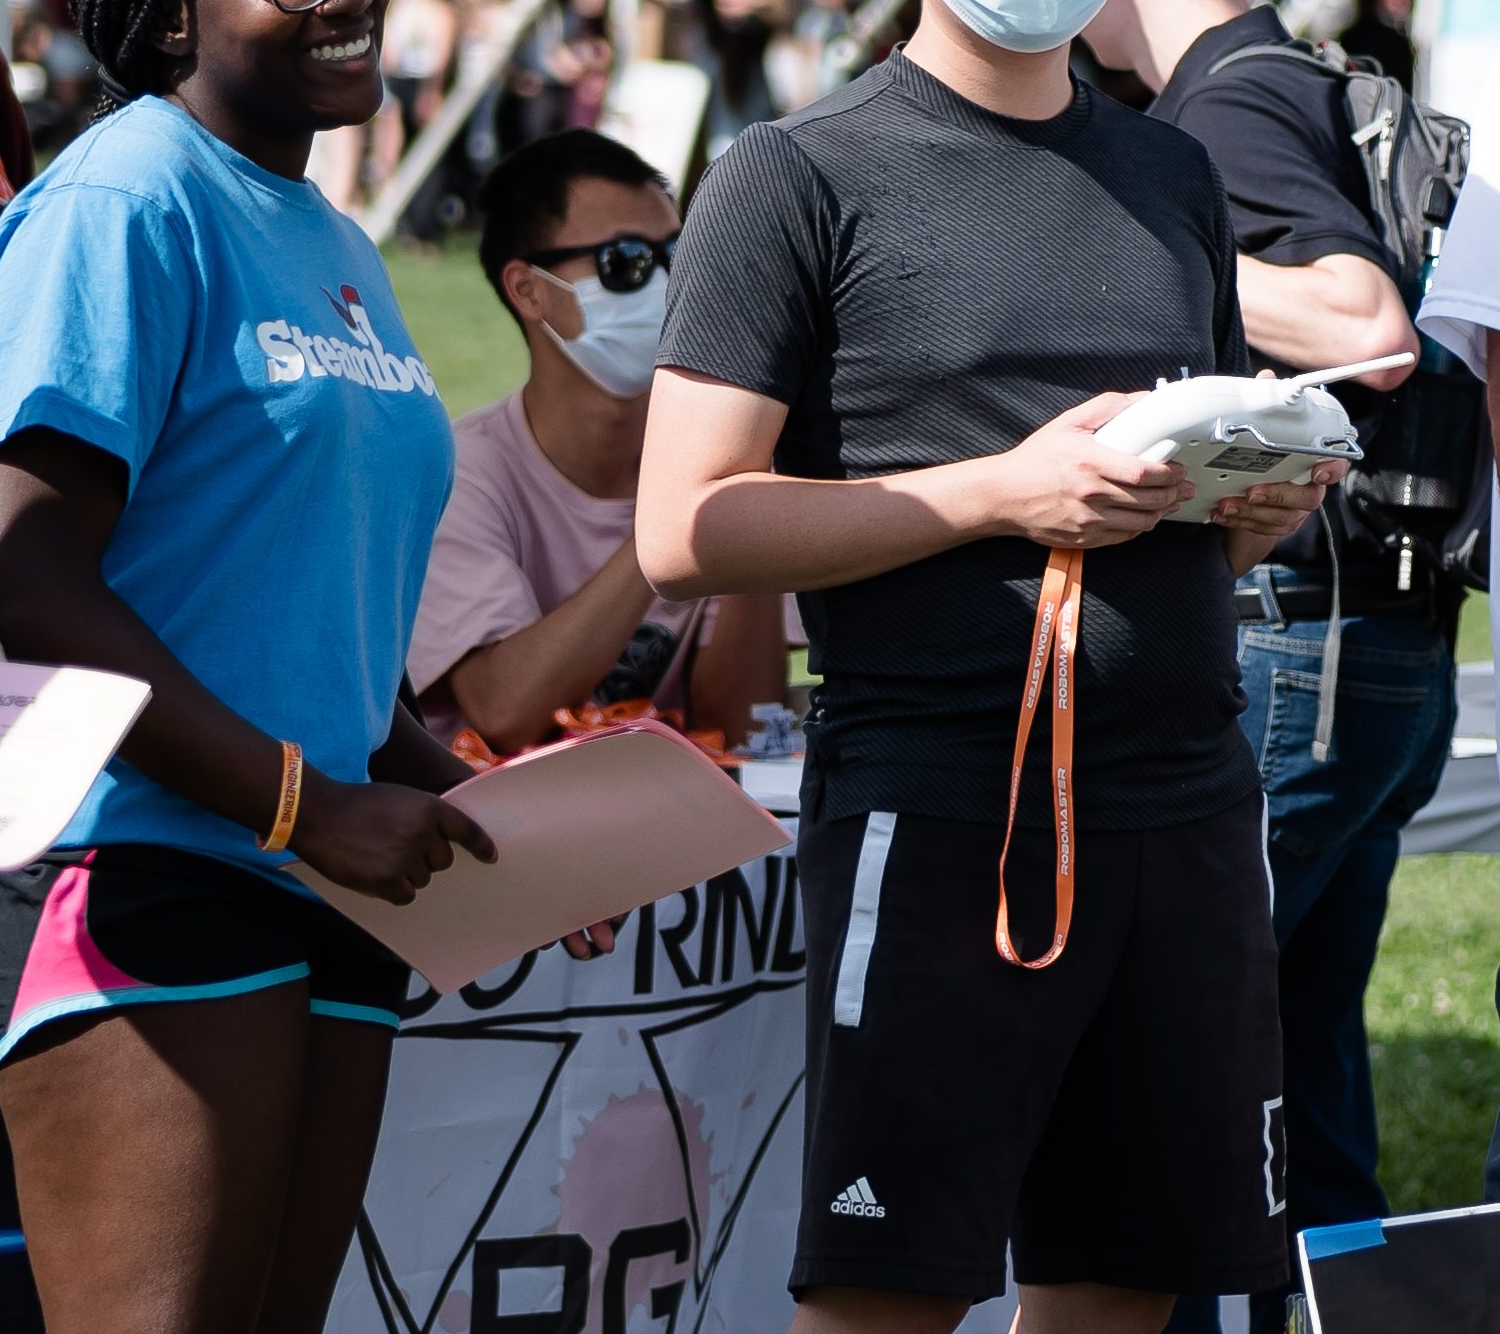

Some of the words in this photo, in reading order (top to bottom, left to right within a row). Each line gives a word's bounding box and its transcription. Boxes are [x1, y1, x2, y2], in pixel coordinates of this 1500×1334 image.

[257, 304, 442, 403] Steambo
[1026, 600, 1056, 710] ROBOMASTER
[1057, 600, 1075, 710] ROBOMASTER
[280, 761, 299, 823] ENGINEERING
[1060, 767, 1069, 877] ROBOMASTER
[831, 1200, 886, 1218] adidas
